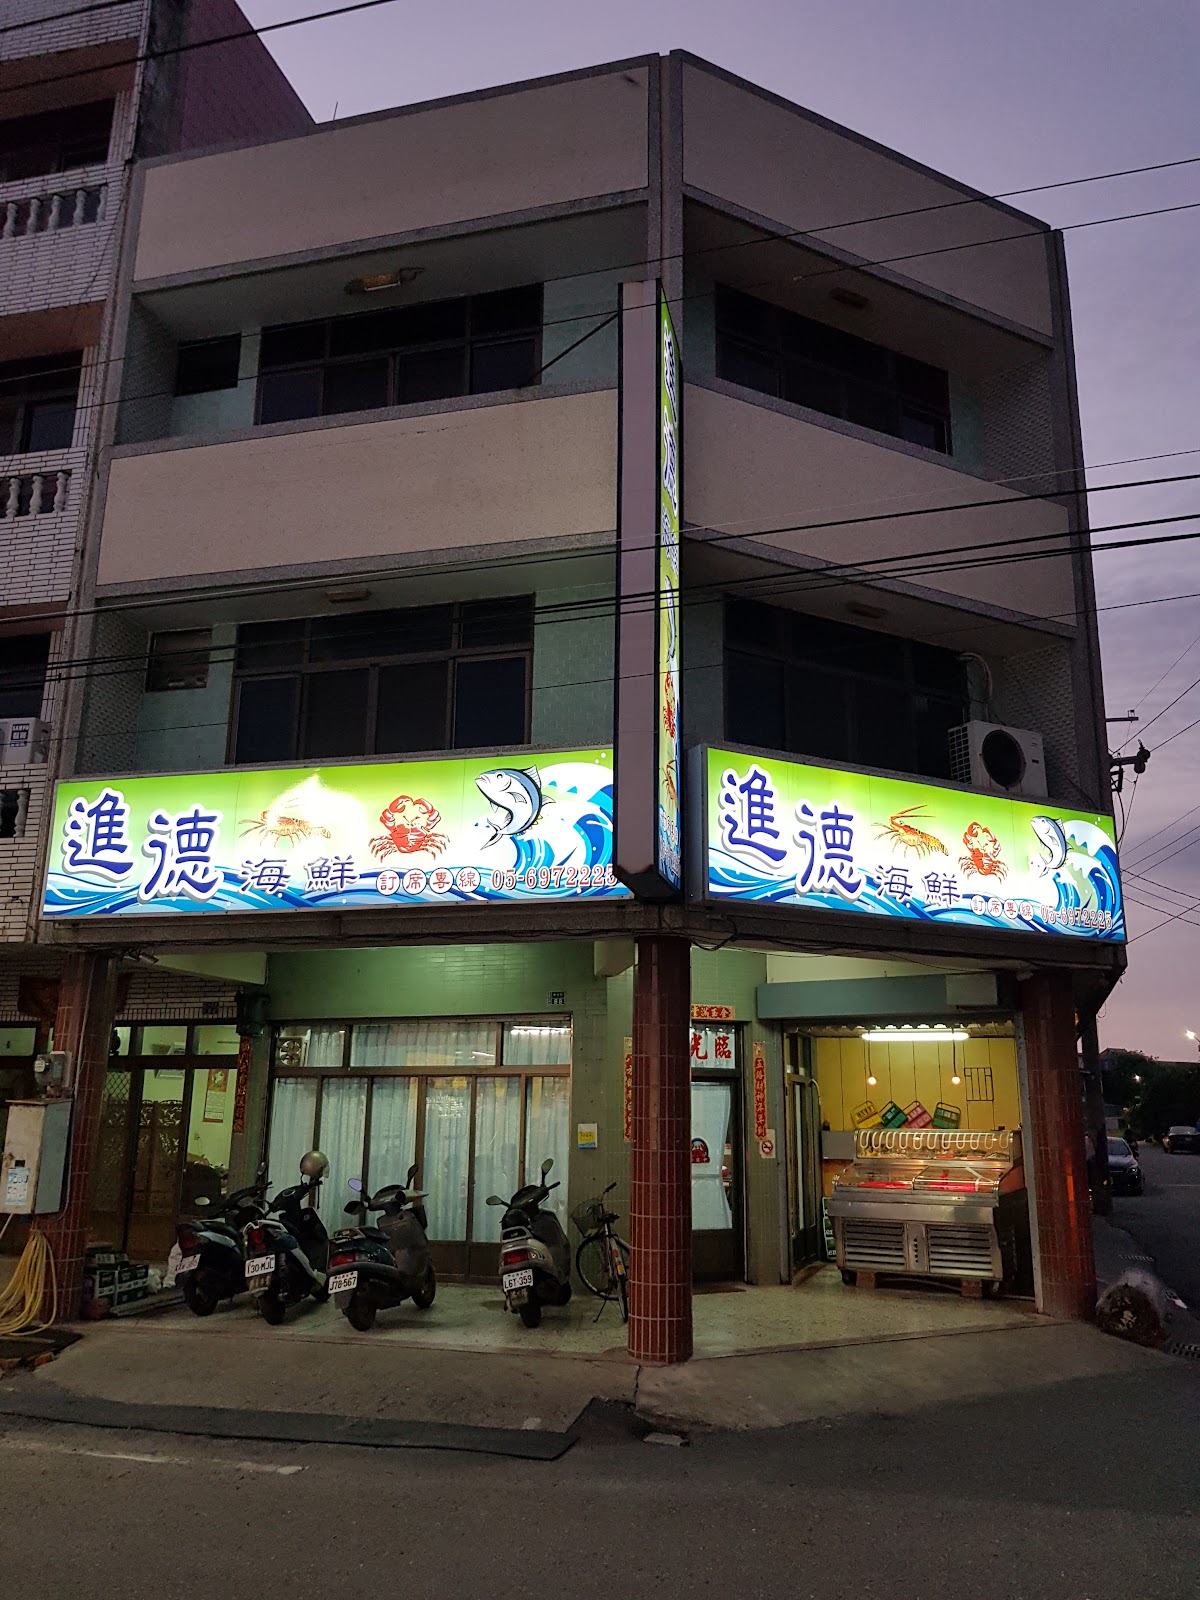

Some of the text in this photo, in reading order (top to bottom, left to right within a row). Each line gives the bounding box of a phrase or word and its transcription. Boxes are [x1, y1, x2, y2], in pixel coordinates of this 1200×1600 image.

[66, 791, 361, 899] 進德海鮮
[725, 768, 962, 907] 進德海鮮
[378, 866, 617, 893] 訂席專線 05-6972225
[972, 897, 1113, 929] 訂席專線 05-6972225
